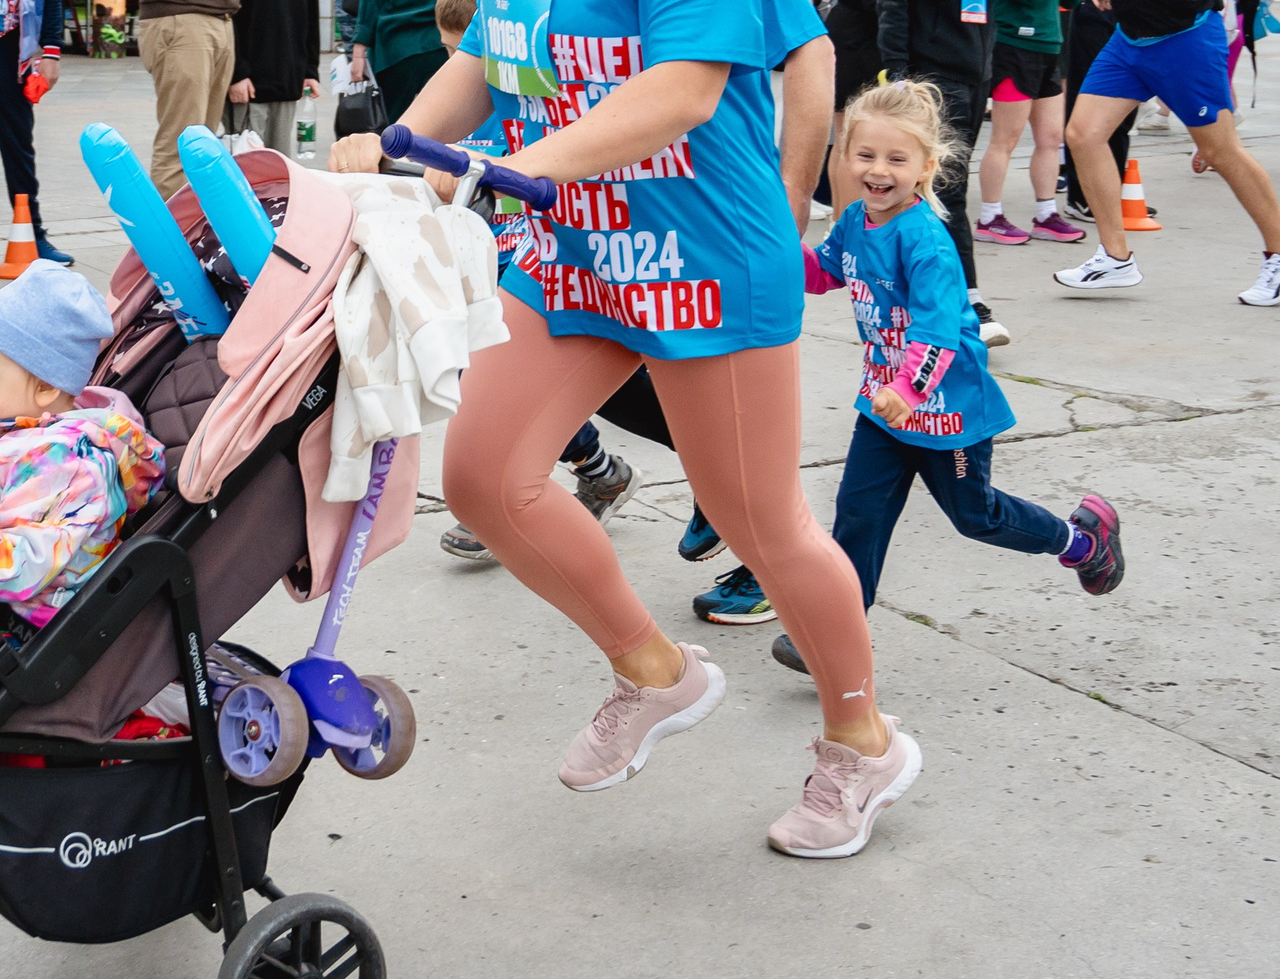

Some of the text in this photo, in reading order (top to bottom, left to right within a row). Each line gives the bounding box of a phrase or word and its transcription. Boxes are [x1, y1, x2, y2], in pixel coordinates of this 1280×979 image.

[487, 16, 528, 61] 10168
[587, 230, 684, 282] 2024
[543, 264, 722, 331] #ЕДИНСТВО
[302, 385, 327, 410] VEGA
[188, 632, 203, 671] designed
[197, 680, 209, 707] RANT
[93, 833, 137, 857] RANT
